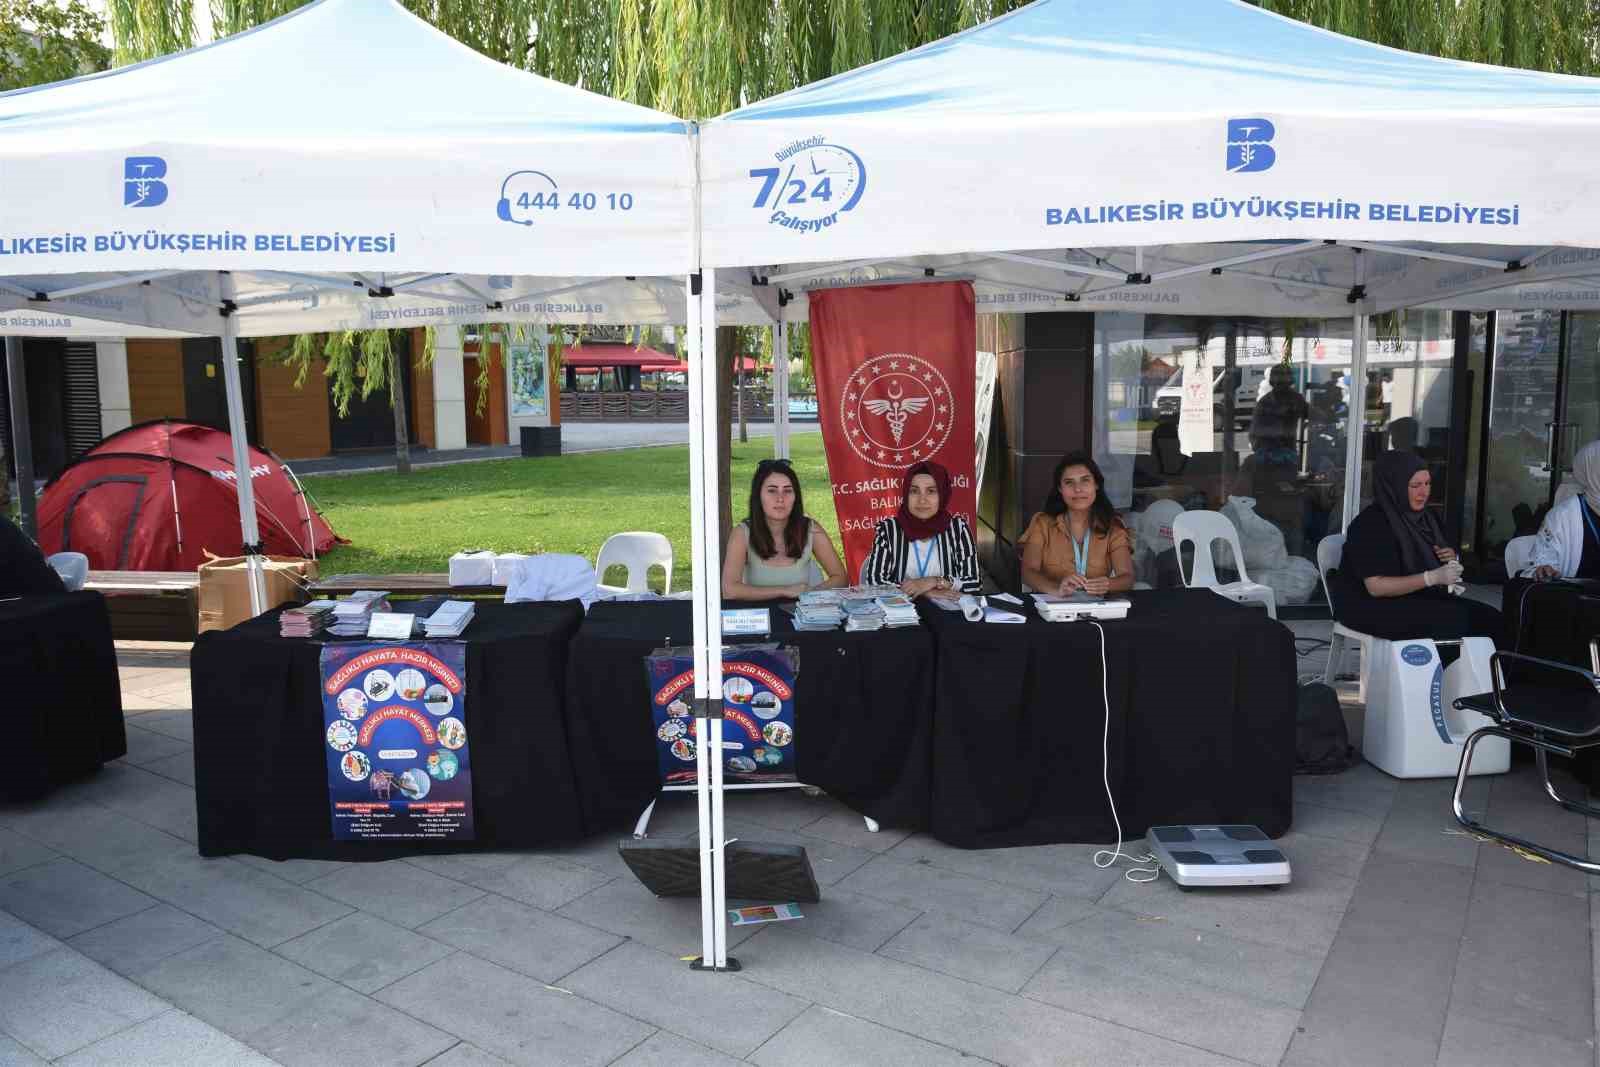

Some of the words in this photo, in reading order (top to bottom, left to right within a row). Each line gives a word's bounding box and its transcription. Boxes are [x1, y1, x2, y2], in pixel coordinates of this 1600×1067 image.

[516, 191, 560, 210] 444
[567, 192, 597, 210] 40
[606, 192, 633, 210] 10
[1046, 200, 1184, 225] BALIKESİR
[1192, 196, 1361, 222] BÜYÜKŞEHİR
[1369, 204, 1520, 225] BELEDİYESİ
[768, 210, 838, 234] Çalışıyor
[95, 231, 247, 255] BÜYÜKŞEHİR
[254, 231, 396, 253] BELEDİYESİ
[855, 477, 899, 493] SAĞLIK
[329, 662, 362, 689] SAĞLIKLI
[362, 652, 397, 666] HAYATA
[400, 652, 428, 665] HAZIR
